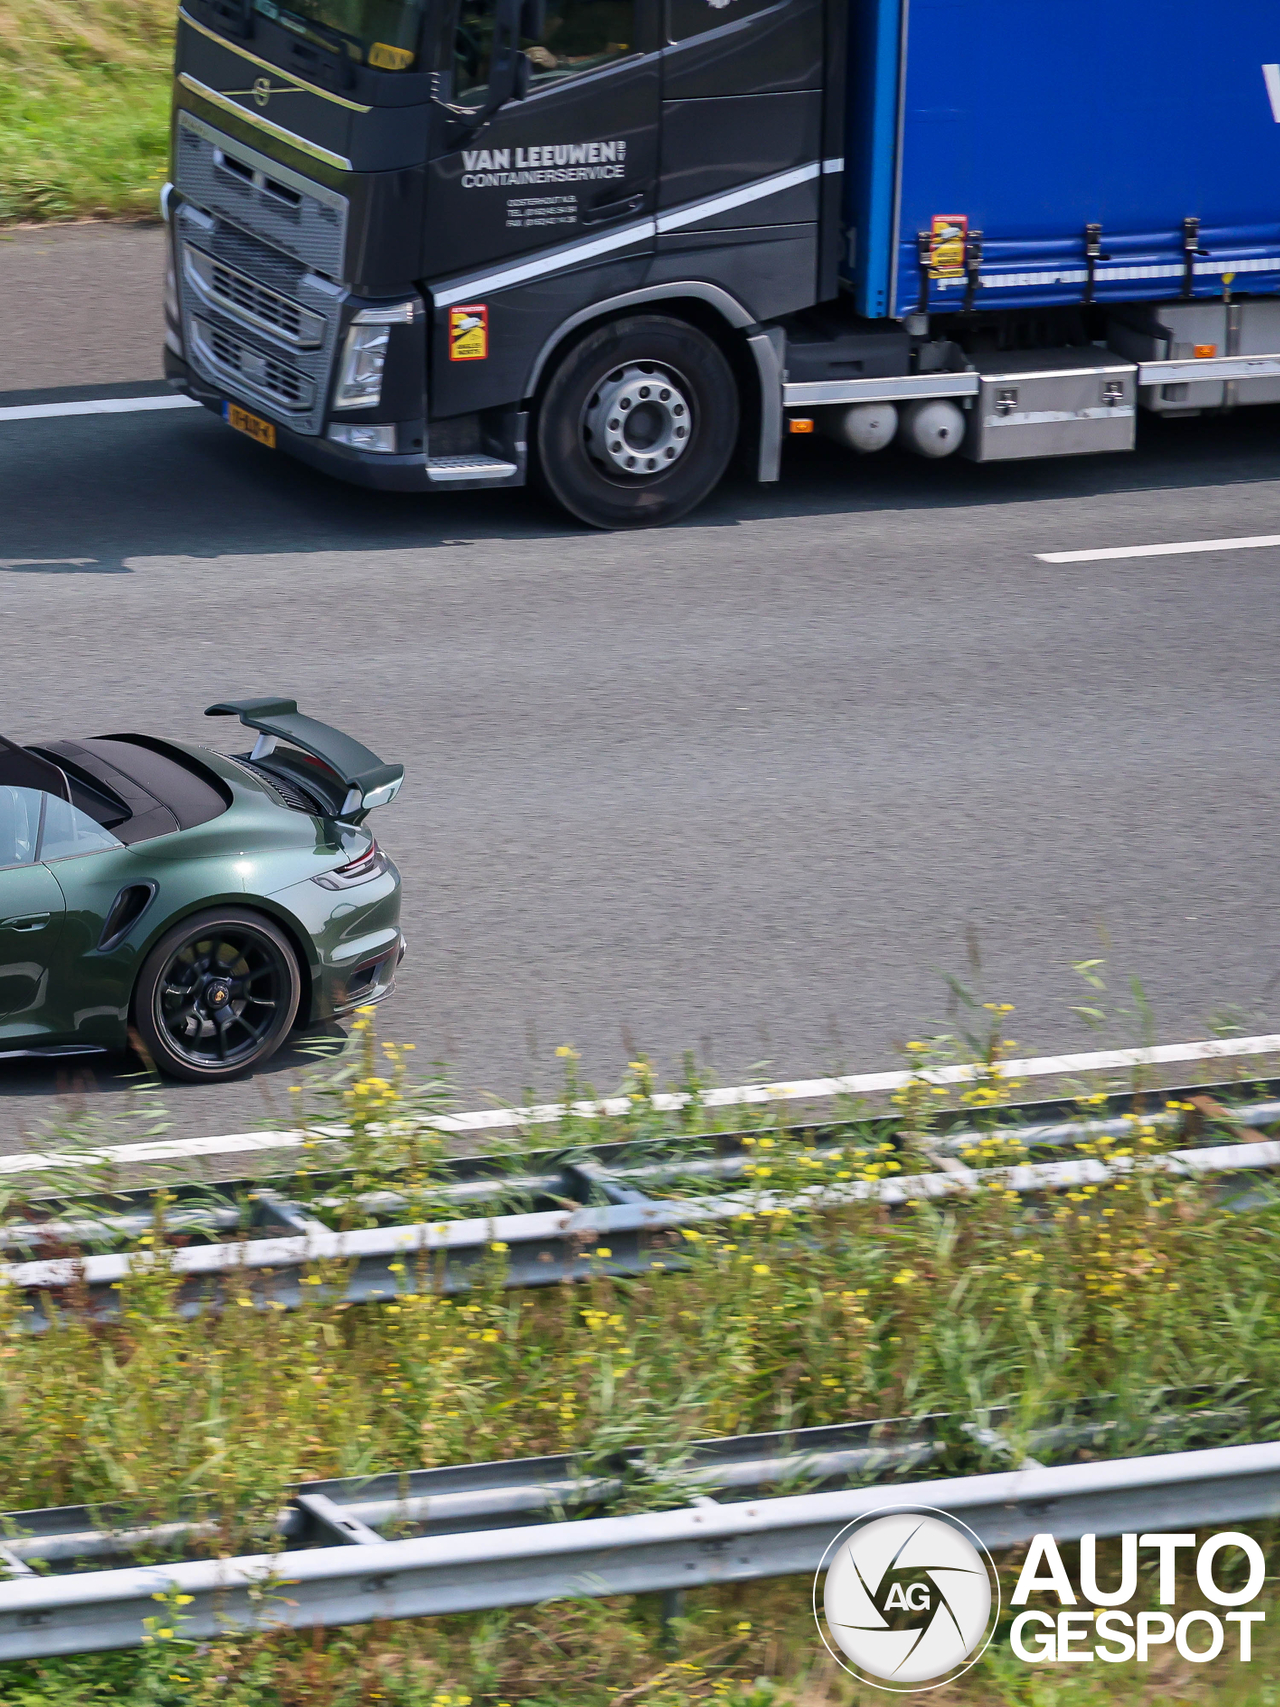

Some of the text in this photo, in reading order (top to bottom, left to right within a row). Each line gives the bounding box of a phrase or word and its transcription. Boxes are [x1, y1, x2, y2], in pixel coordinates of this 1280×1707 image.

[461, 149, 510, 171] VAN
[515, 141, 616, 169] LEEUWEN
[461, 164, 626, 188] CONTAINERSERVICE
